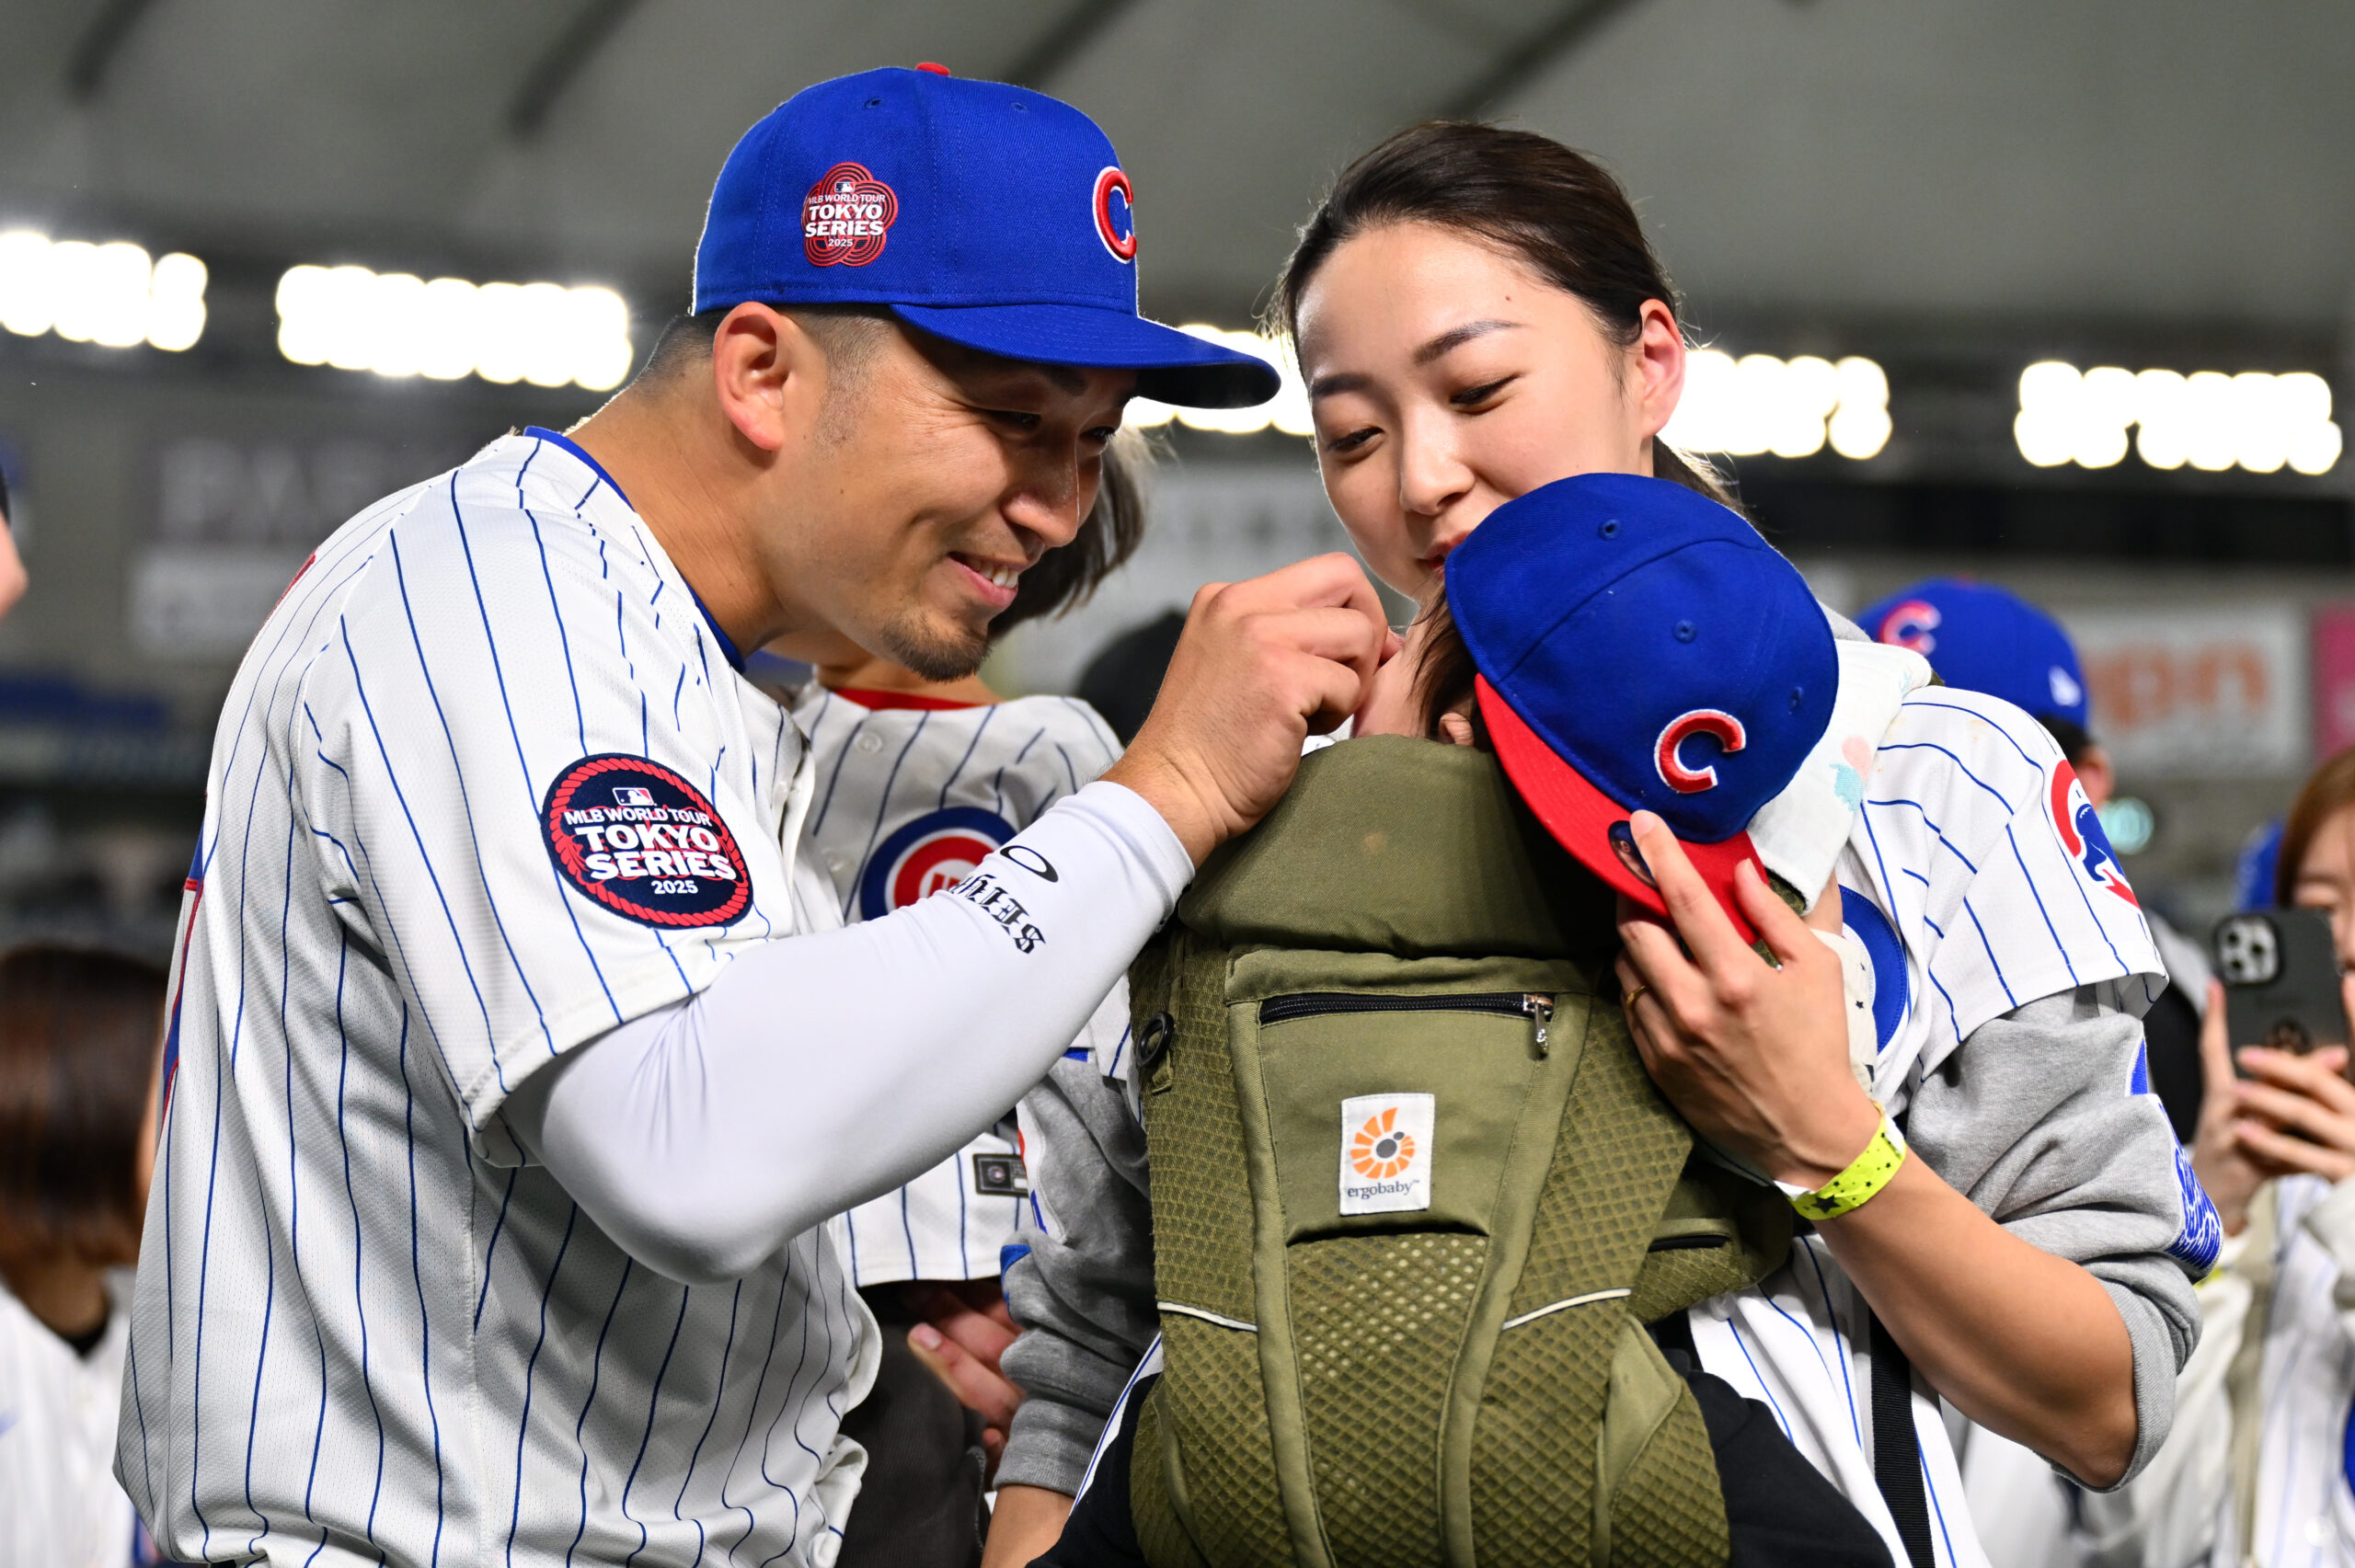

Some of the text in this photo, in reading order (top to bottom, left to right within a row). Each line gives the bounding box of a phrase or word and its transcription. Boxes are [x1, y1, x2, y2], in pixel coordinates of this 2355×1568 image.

[810, 194, 886, 204] MLB WORLD TOUR
[809, 204, 883, 221] TOKYO
[1092, 166, 1137, 264] C
[805, 221, 884, 237] SERIES
[1654, 708, 1746, 794] C
[563, 807, 713, 827] MLB WORLD TOUR
[574, 823, 719, 853] TOKYO
[585, 850, 737, 880] SERIES
[651, 880, 698, 894] 2025
